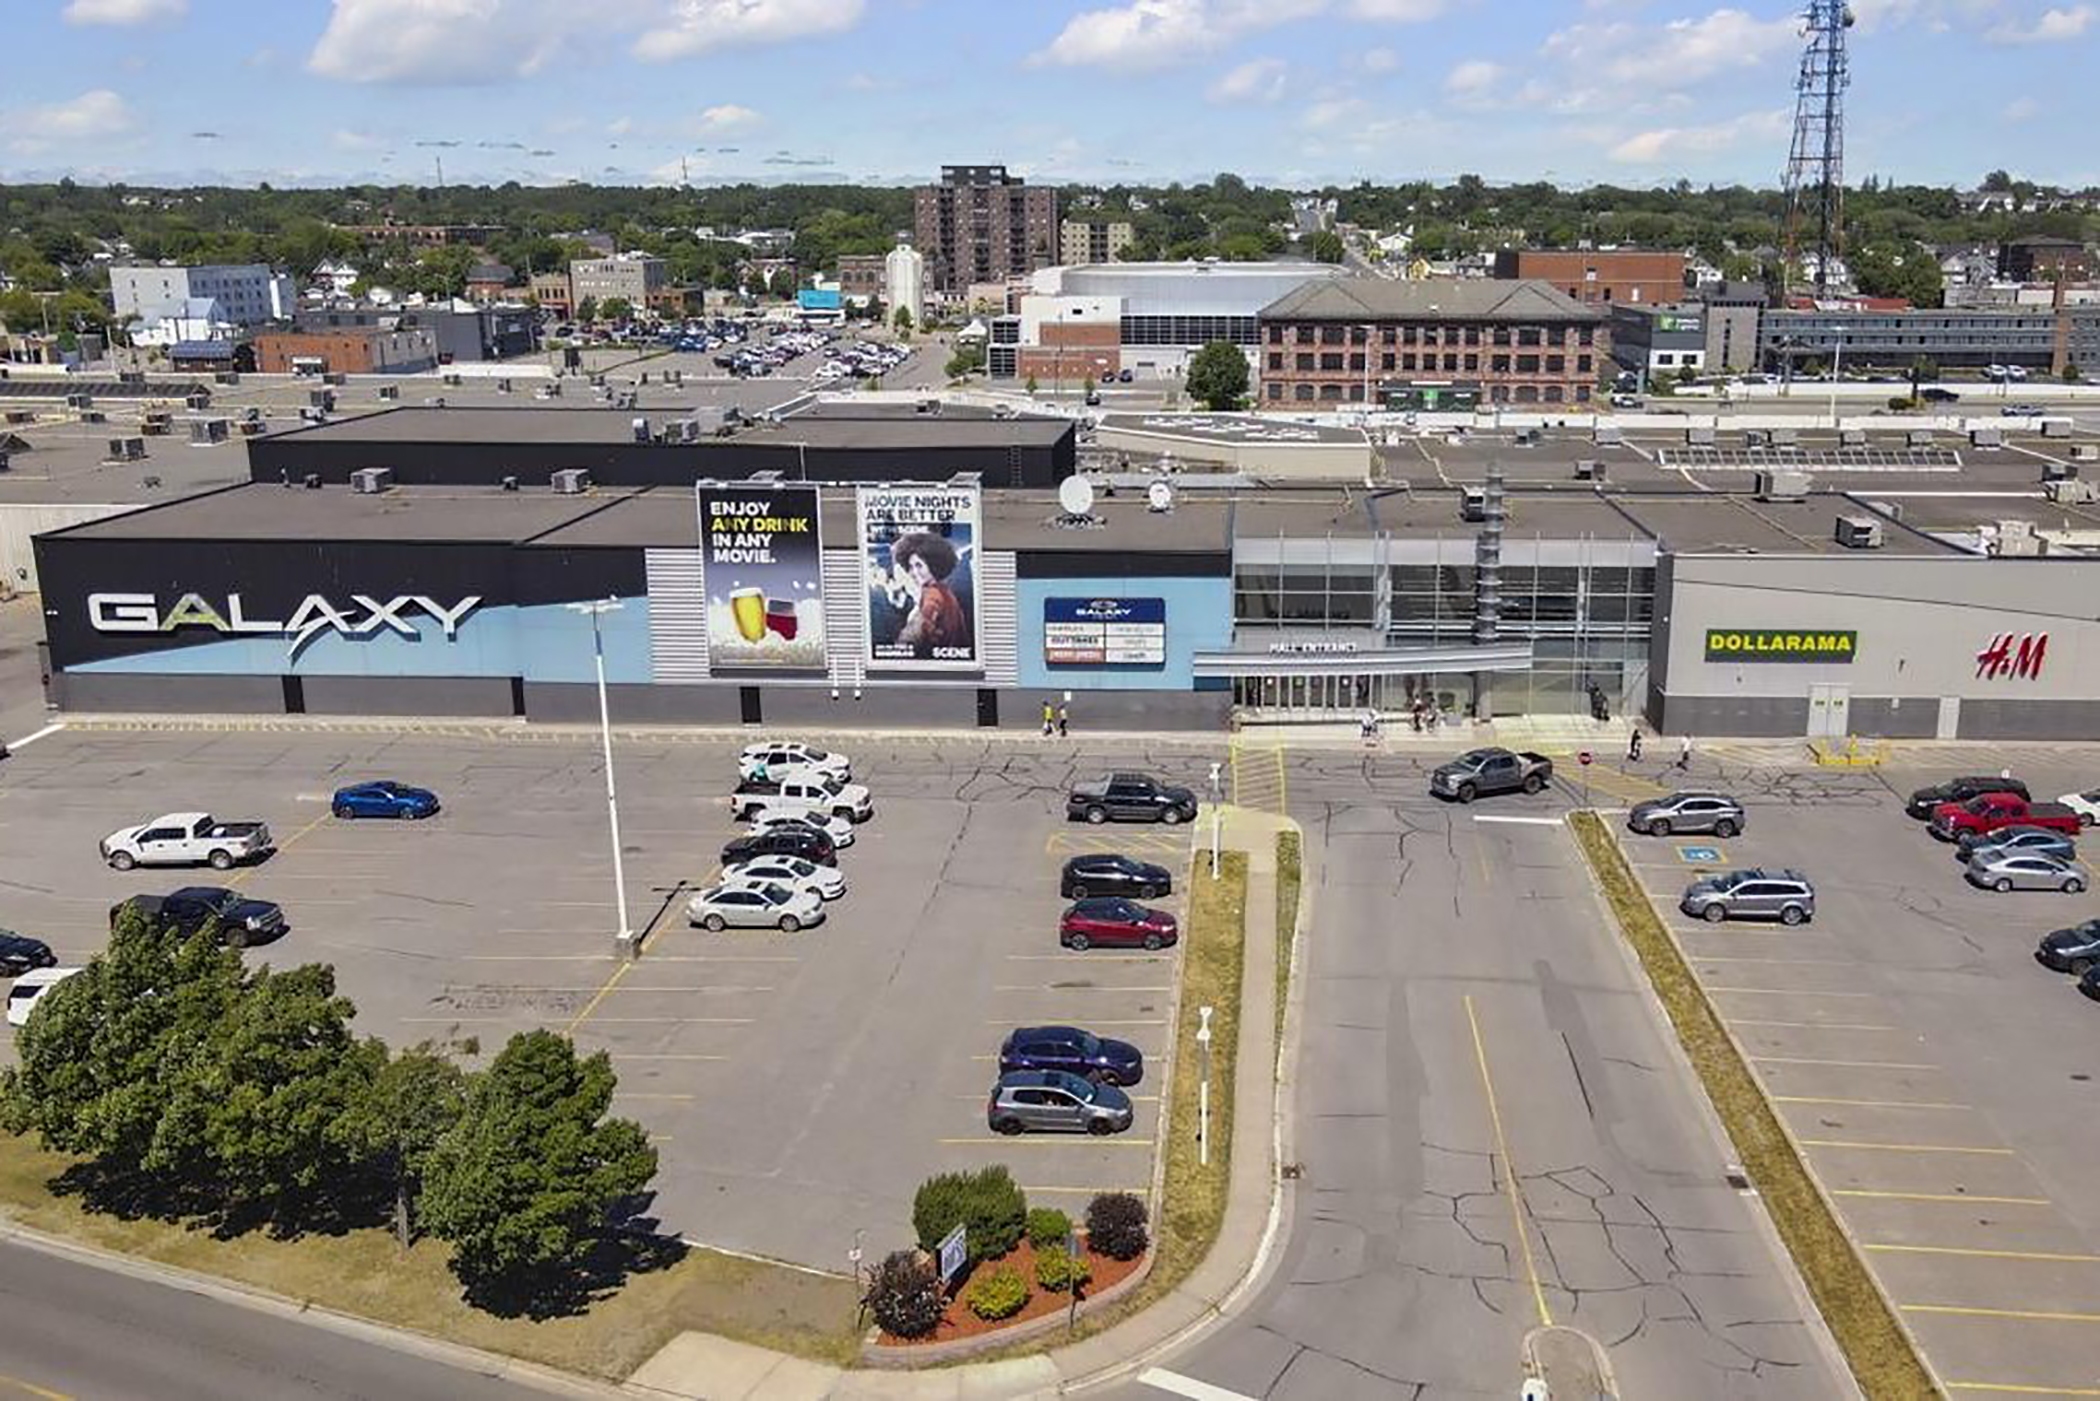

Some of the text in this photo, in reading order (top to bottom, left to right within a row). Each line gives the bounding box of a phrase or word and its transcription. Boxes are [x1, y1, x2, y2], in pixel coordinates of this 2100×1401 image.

[865, 495, 972, 508] MOVIE NIGHTS
[710, 502, 770, 516] ENJOY
[866, 509, 955, 521] ARE BETTER
[711, 518, 808, 532] ANY DRINK
[713, 534, 772, 548] IN ANY
[714, 550, 776, 563] MOVIE.
[1075, 608, 1131, 616] GALAXY
[88, 593, 481, 656] GALAXY
[1269, 641, 1358, 654] MALL ENTRANCE
[1710, 634, 1851, 652] DOLLARAMA
[1975, 631, 2049, 680] H&M
